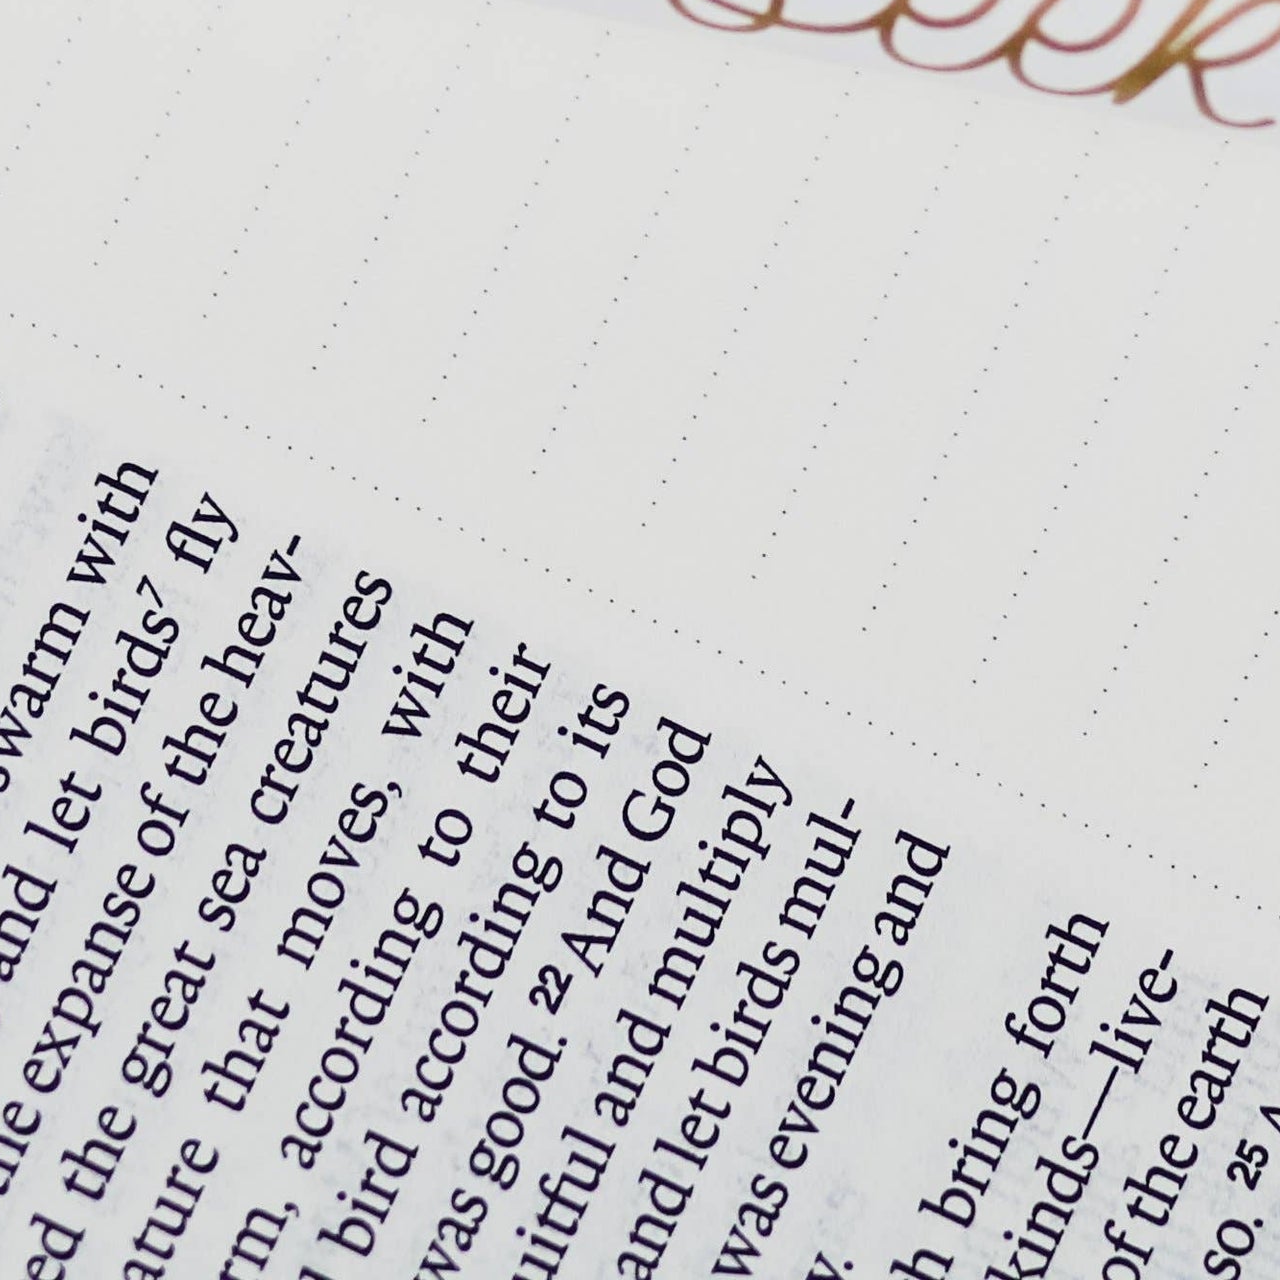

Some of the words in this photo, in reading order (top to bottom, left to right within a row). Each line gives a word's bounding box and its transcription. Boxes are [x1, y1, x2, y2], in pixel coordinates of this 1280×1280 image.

[65, 461, 160, 586] with
[22, 770, 103, 856] let
[164, 490, 240, 575] fly
[199, 534, 303, 690] heav-
[161, 691, 240, 787] the
[556, 682, 631, 761] its
[136, 780, 191, 858] of
[200, 987, 291, 1113] that
[276, 780, 404, 972] moves,
[380, 611, 475, 738] with
[531, 770, 589, 831] to
[777, 797, 863, 941] mul-
[59, 1105, 138, 1202] the
[120, 938, 217, 1099] great
[197, 842, 268, 933] sea
[249, 569, 394, 826] creatures
[280, 886, 445, 1171] according
[416, 808, 474, 868] to
[453, 641, 552, 784] their
[468, 1032, 569, 1192] good.
[527, 963, 574, 1017] 22
[559, 843, 653, 980] And
[621, 715, 713, 843] God
[593, 1007, 673, 1128] and
[647, 753, 794, 1012] multiply
[22, 862, 157, 1095] expanse
[399, 839, 564, 1124] according
[689, 939, 802, 1088] birds
[710, 1173, 790, 1277] was
[768, 943, 905, 1171] evening
[873, 828, 952, 947] and
[652, 1087, 732, 1173] let
[916, 1066, 1043, 1230] bring
[1003, 913, 1111, 1061] forth
[1121, 1133, 1200, 1228] the
[1176, 987, 1271, 1131] earth
[315, 1129, 420, 1258] bird
[615, 1167, 695, 1280] and
[1225, 1137, 1270, 1192] 25
[1202, 1217, 1265, 1280] so.
